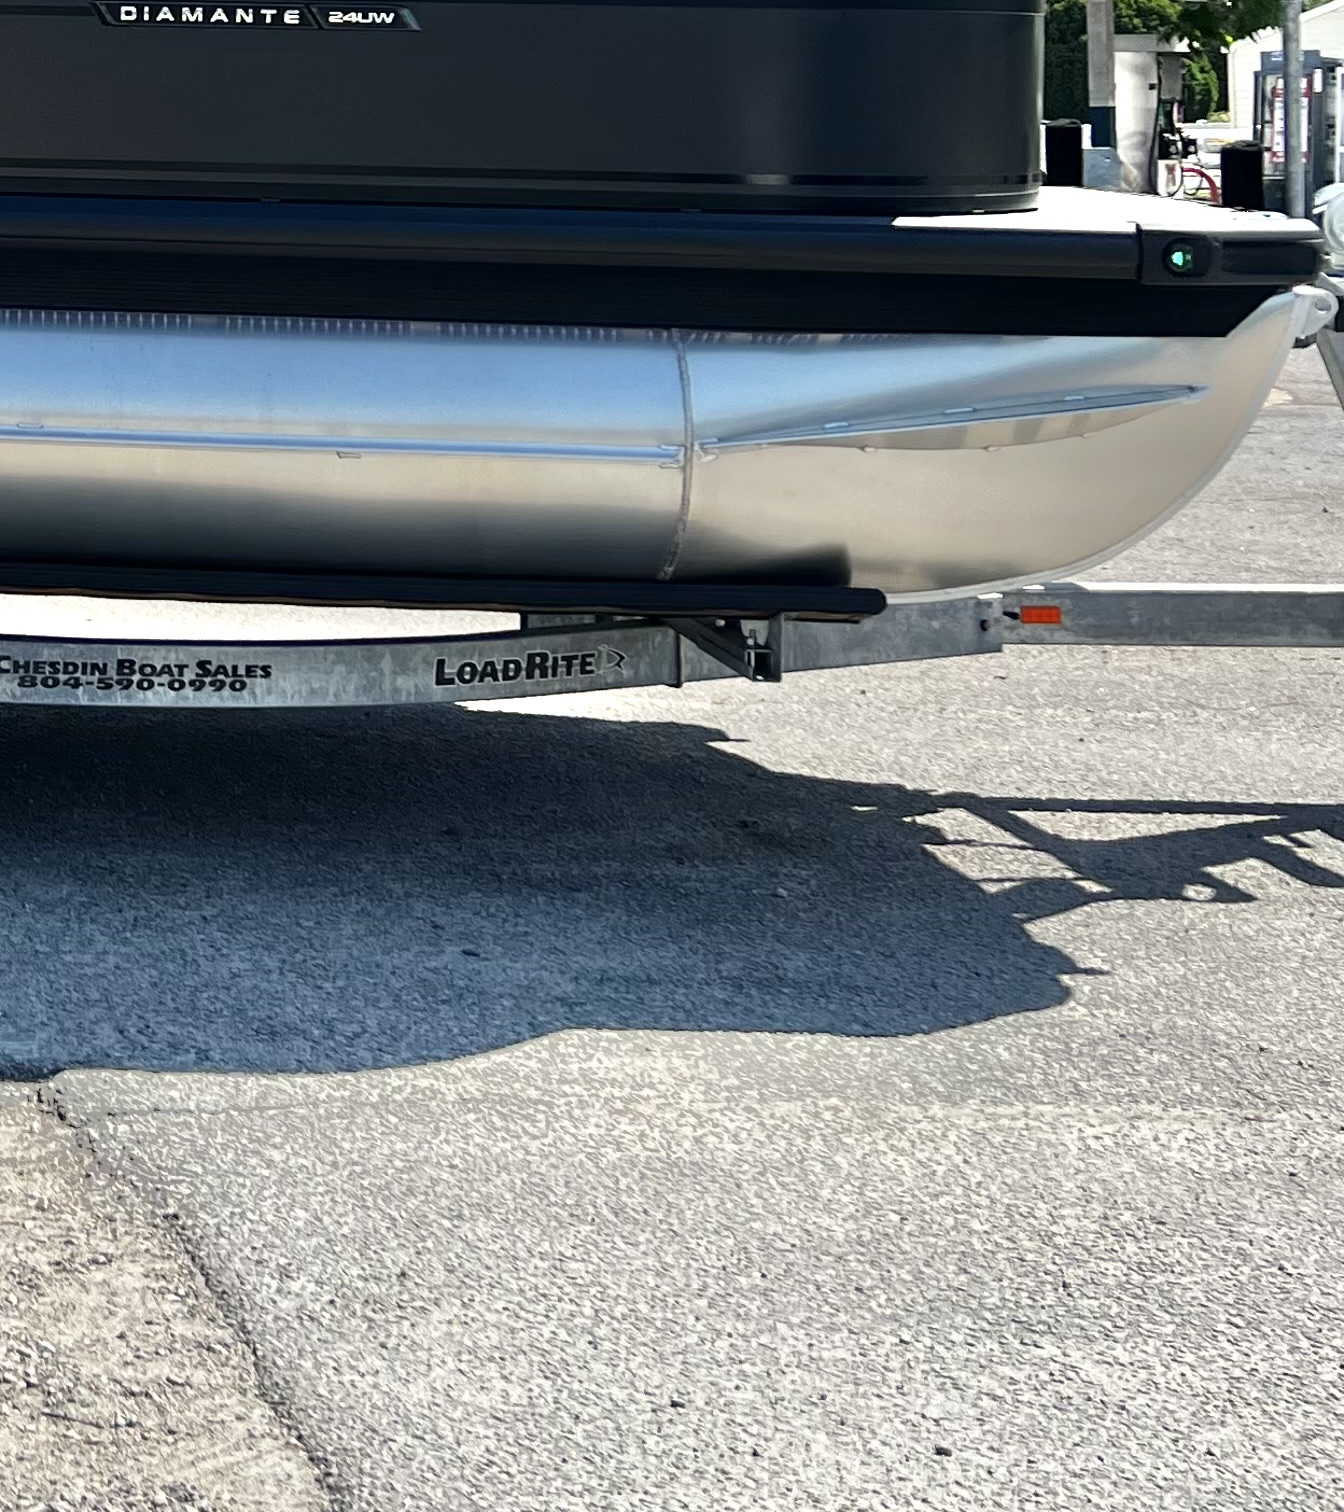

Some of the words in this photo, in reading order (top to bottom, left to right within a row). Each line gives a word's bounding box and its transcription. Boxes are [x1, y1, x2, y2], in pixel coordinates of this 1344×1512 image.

[120, 5, 300, 25] DIAMANTE
[115, 658, 190, 678] BOAT
[195, 659, 273, 679] SALES
[16, 675, 248, 692] 804-590-0990
